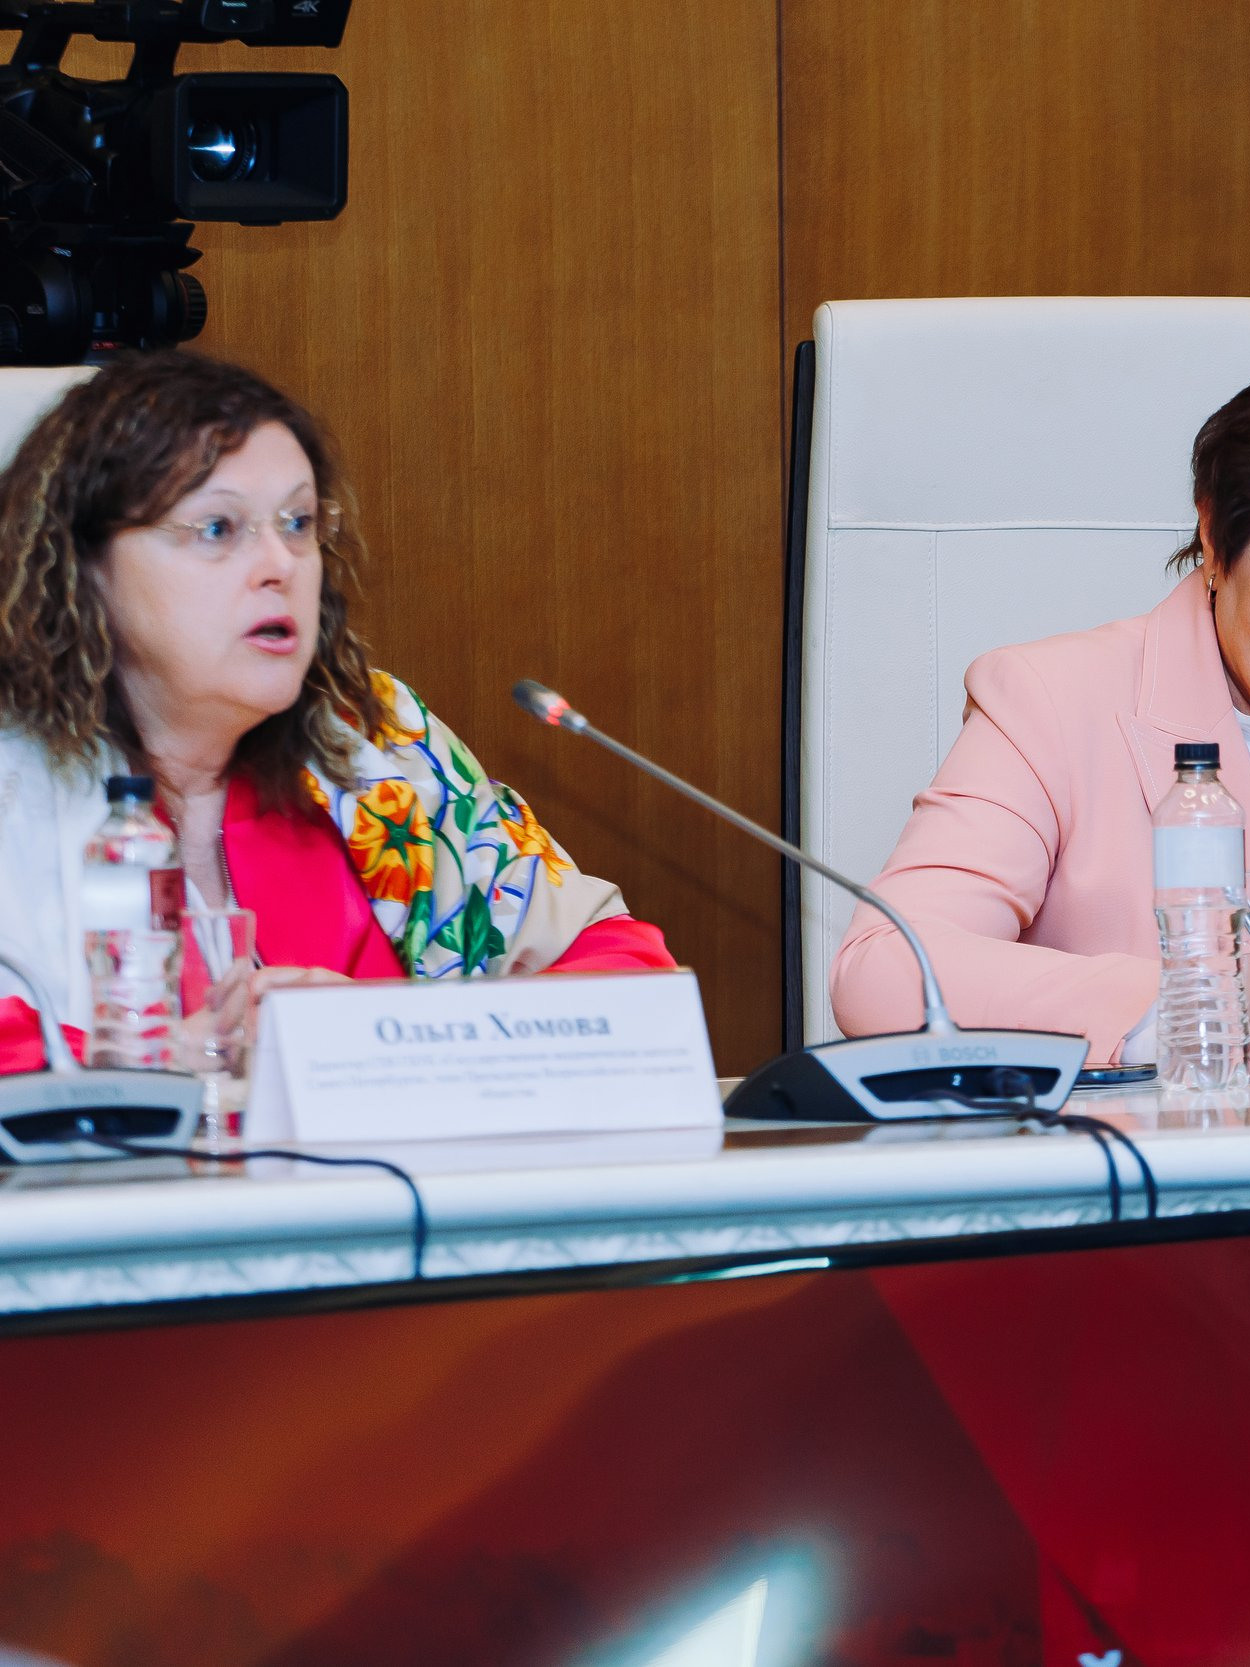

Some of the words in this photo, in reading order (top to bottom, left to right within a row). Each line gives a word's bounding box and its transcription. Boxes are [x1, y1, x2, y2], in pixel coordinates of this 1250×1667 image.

[374, 1016, 478, 1046] Ольга
[487, 1013, 612, 1041] Хомова
[938, 1046, 998, 1062] BOSCH
